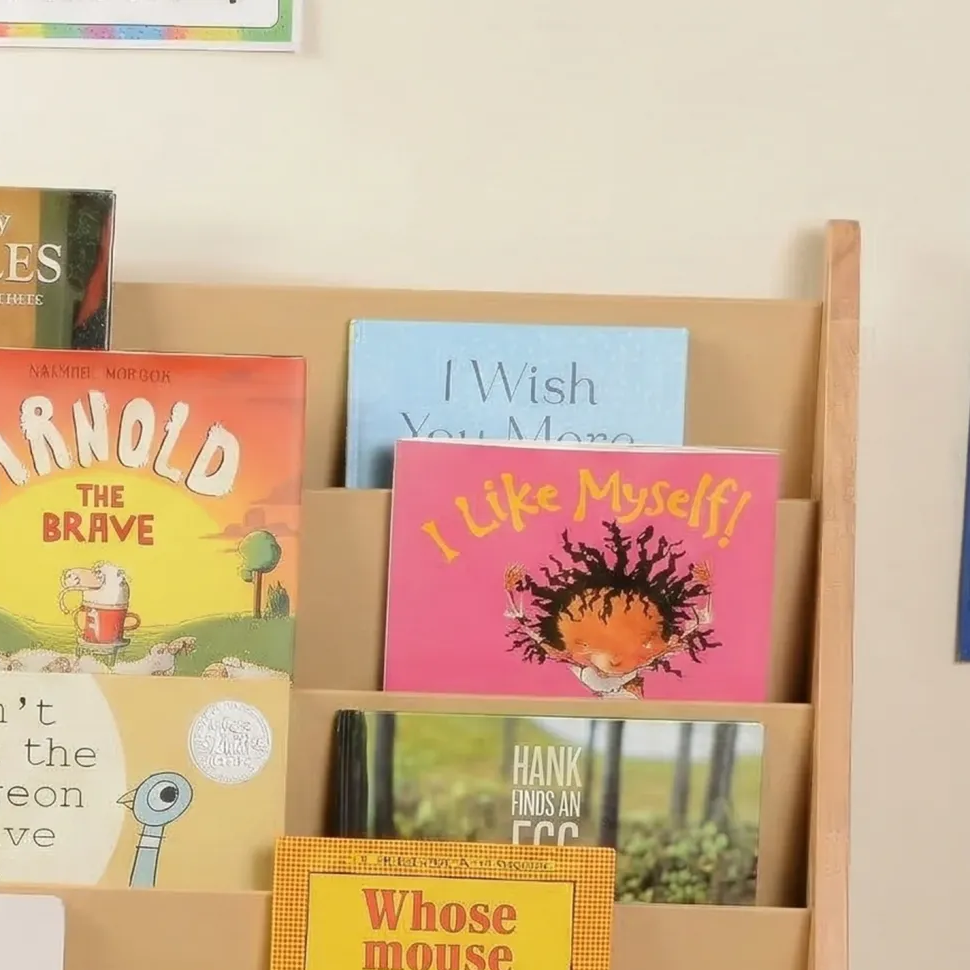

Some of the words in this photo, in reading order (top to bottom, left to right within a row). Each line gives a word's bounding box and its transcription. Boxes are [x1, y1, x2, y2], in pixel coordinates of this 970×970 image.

[444, 359, 453, 402] I
[471, 361, 598, 406] Wish
[76, 483, 125, 509] THE
[42, 512, 155, 546] BRAVE
[421, 520, 461, 564] I
[455, 472, 561, 538] Like
[573, 468, 752, 549] Myself!
[24, 737, 97, 768] the
[513, 745, 582, 787] HANK
[511, 789, 555, 816] FINDS
[558, 790, 581, 817] AN
[362, 888, 517, 935] Whose
